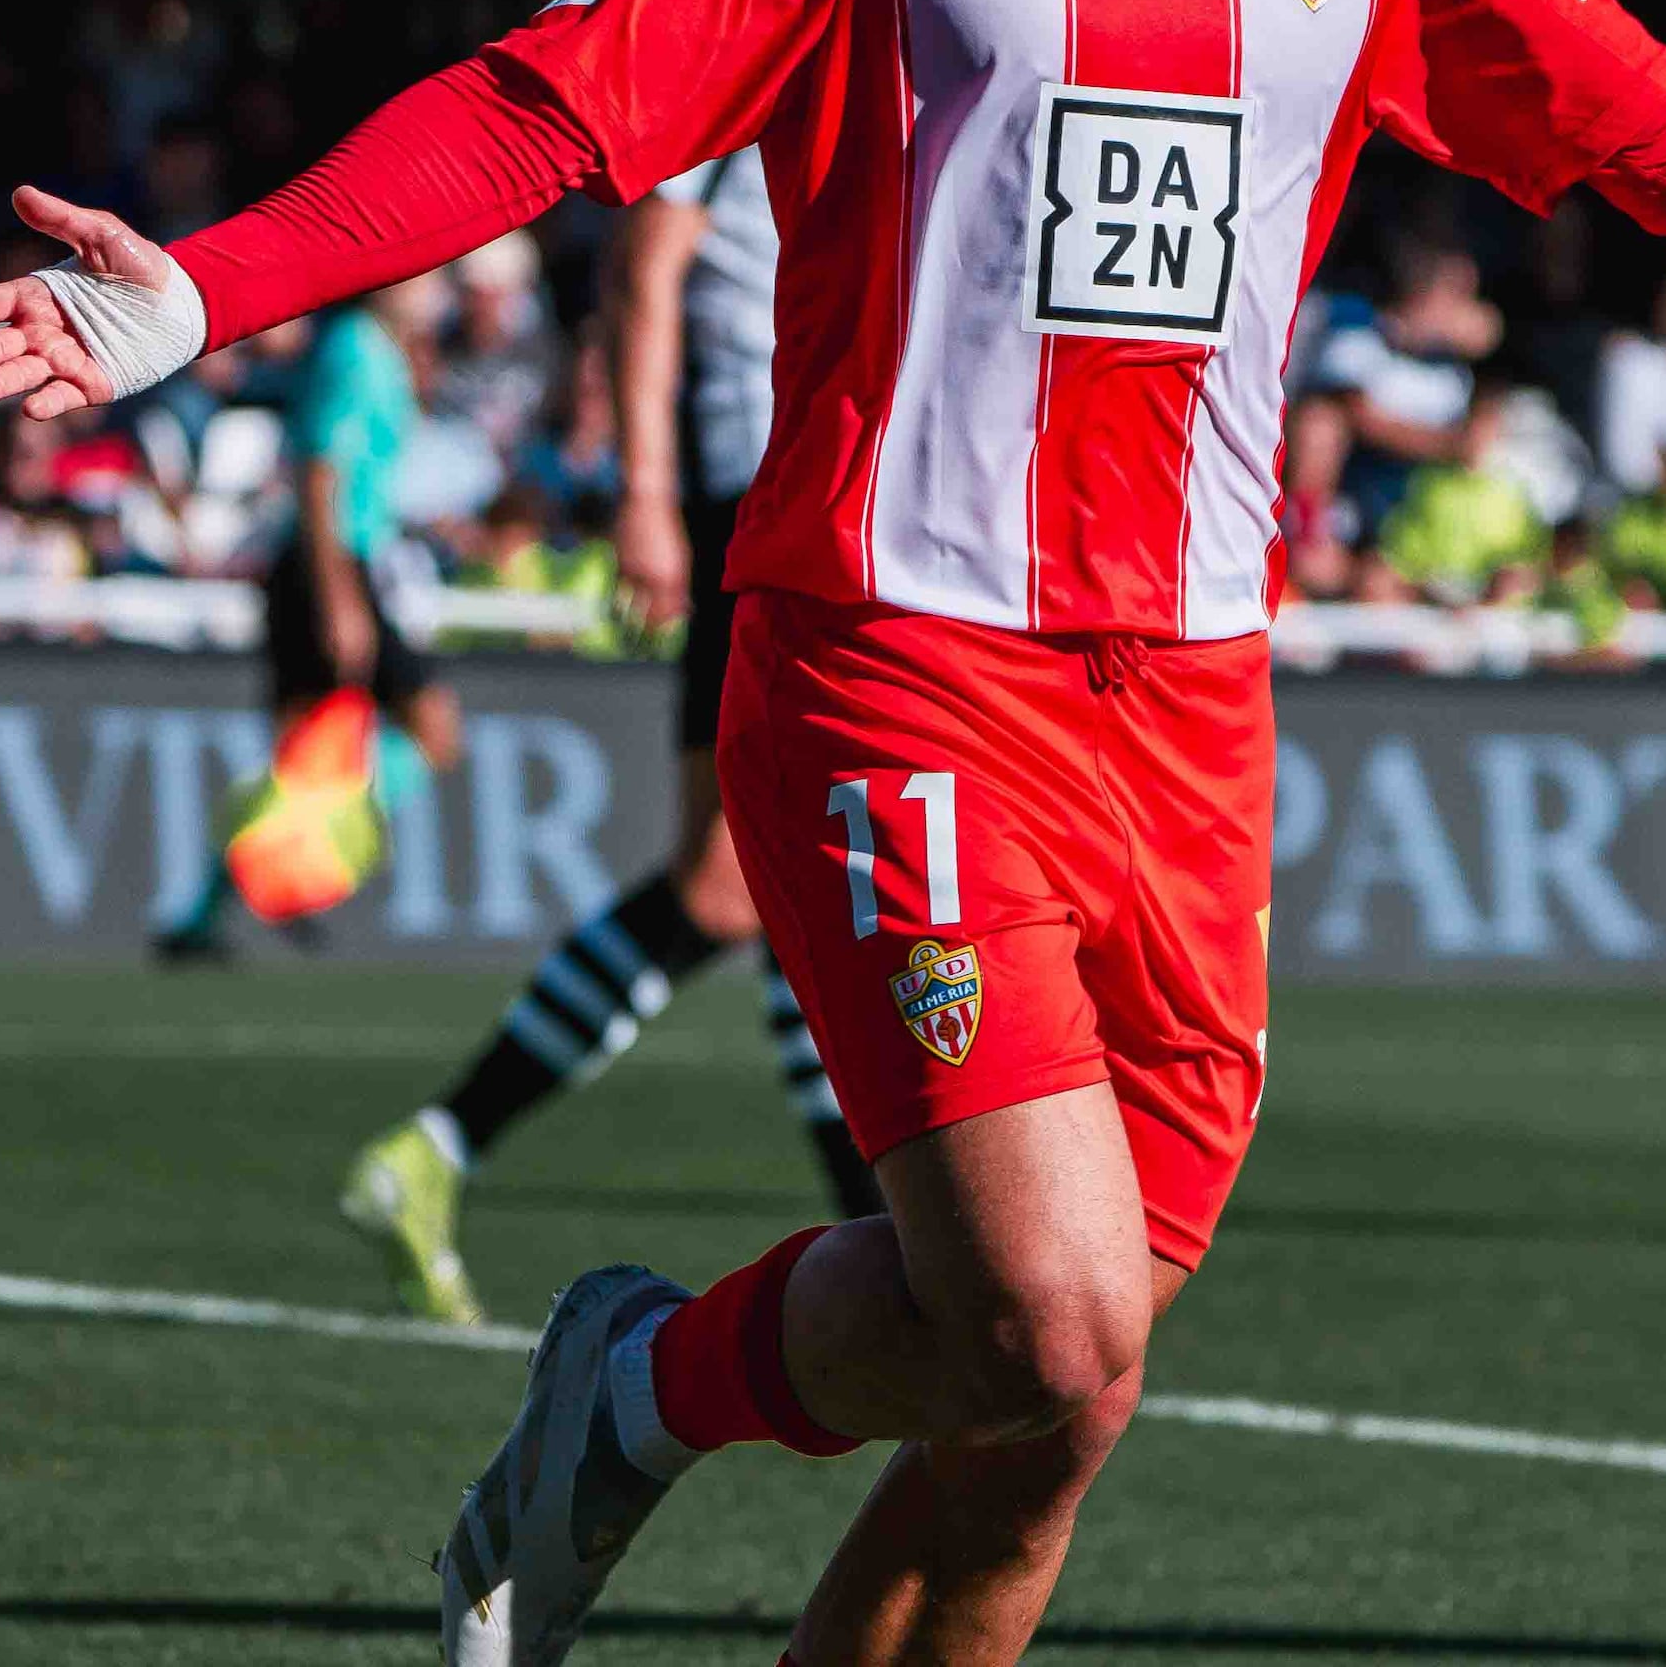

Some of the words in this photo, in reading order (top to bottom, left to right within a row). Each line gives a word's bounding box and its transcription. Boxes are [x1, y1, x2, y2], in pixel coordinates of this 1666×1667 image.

[1097, 139, 1199, 212] DA
[1093, 221, 1193, 290] ZN
[826, 772, 962, 941] 11
[909, 982, 976, 1015] ALMERIA
